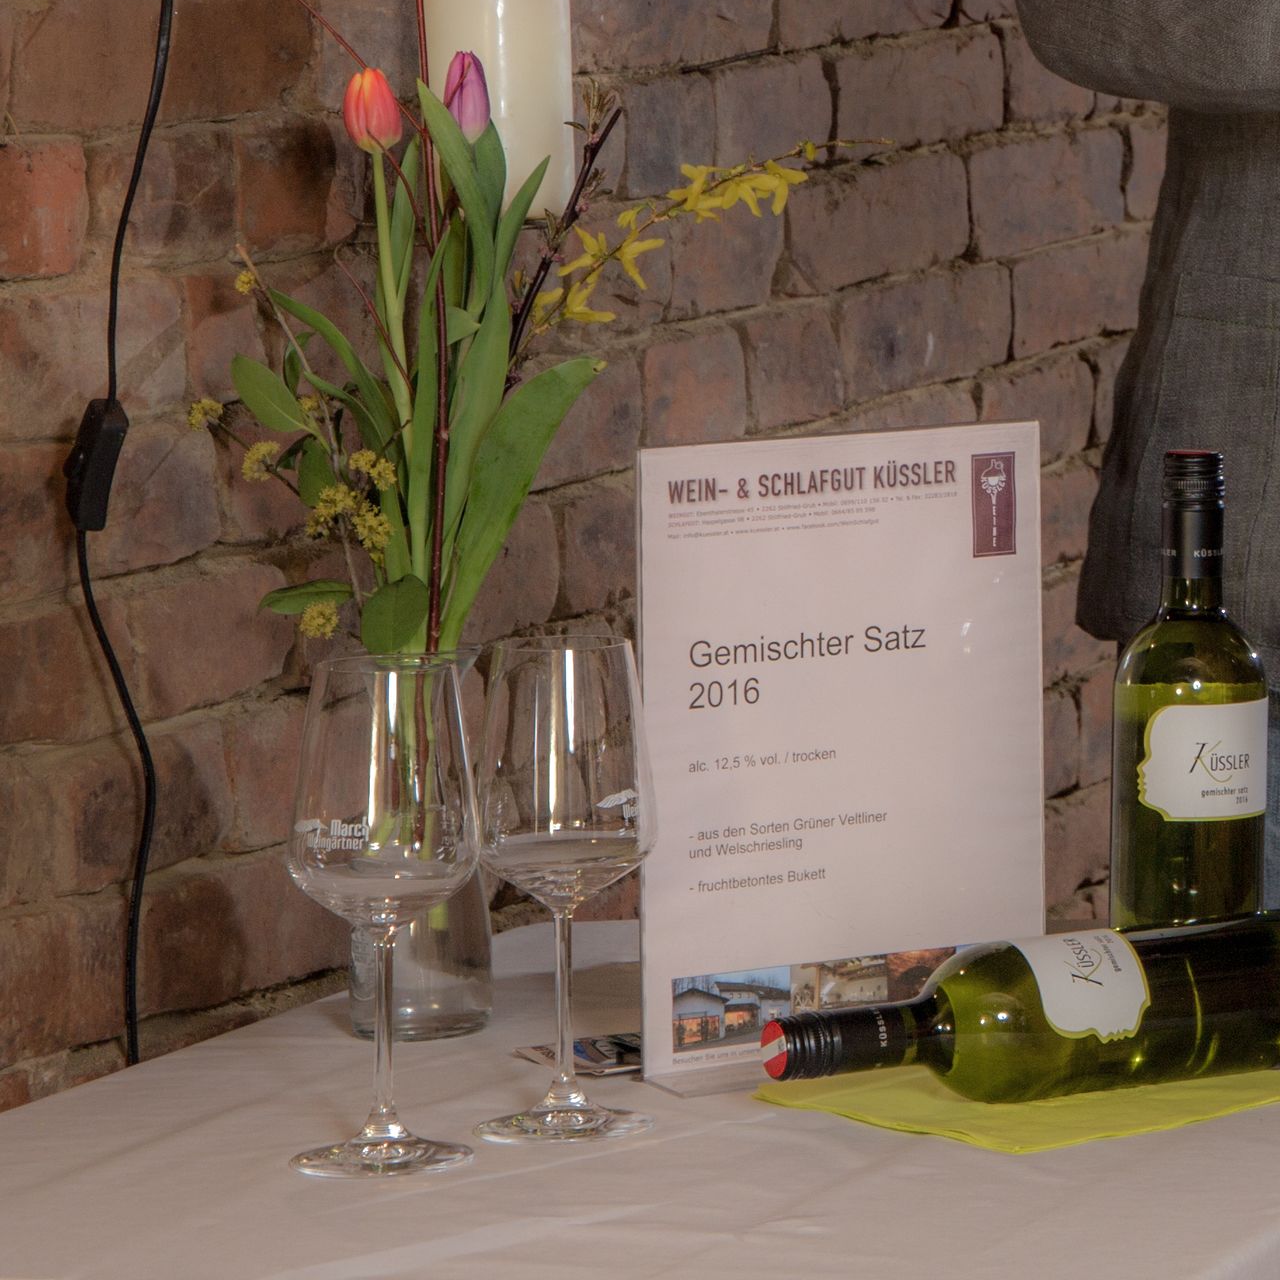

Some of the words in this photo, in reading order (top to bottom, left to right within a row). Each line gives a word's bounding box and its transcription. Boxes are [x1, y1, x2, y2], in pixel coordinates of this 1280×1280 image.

[668, 478, 728, 504] WEIN-
[737, 478, 750, 499] &
[758, 467, 866, 498] SCHLAFGUT
[874, 460, 956, 489] KÜSSLER
[689, 631, 854, 668] Gemischter
[864, 625, 926, 653] Satz
[689, 677, 760, 709] 2016
[688, 760, 710, 773] alc.
[715, 756, 741, 770] 12,5
[744, 755, 756, 767] %
[760, 753, 781, 766] vol.
[792, 749, 837, 763] trocken
[1189, 740, 1250, 783] KÜSSLER
[330, 816, 369, 841] March
[697, 830, 719, 841] aus
[722, 827, 746, 839] den
[749, 822, 790, 835] Sorten
[793, 816, 836, 830] Grüner
[838, 811, 887, 825] Veltliner
[308, 832, 364, 851] Weingärtner
[689, 847, 712, 859] und
[715, 837, 803, 856] Welschriesling
[697, 873, 784, 893] fruchtbetontes
[787, 868, 827, 883] Bukett
